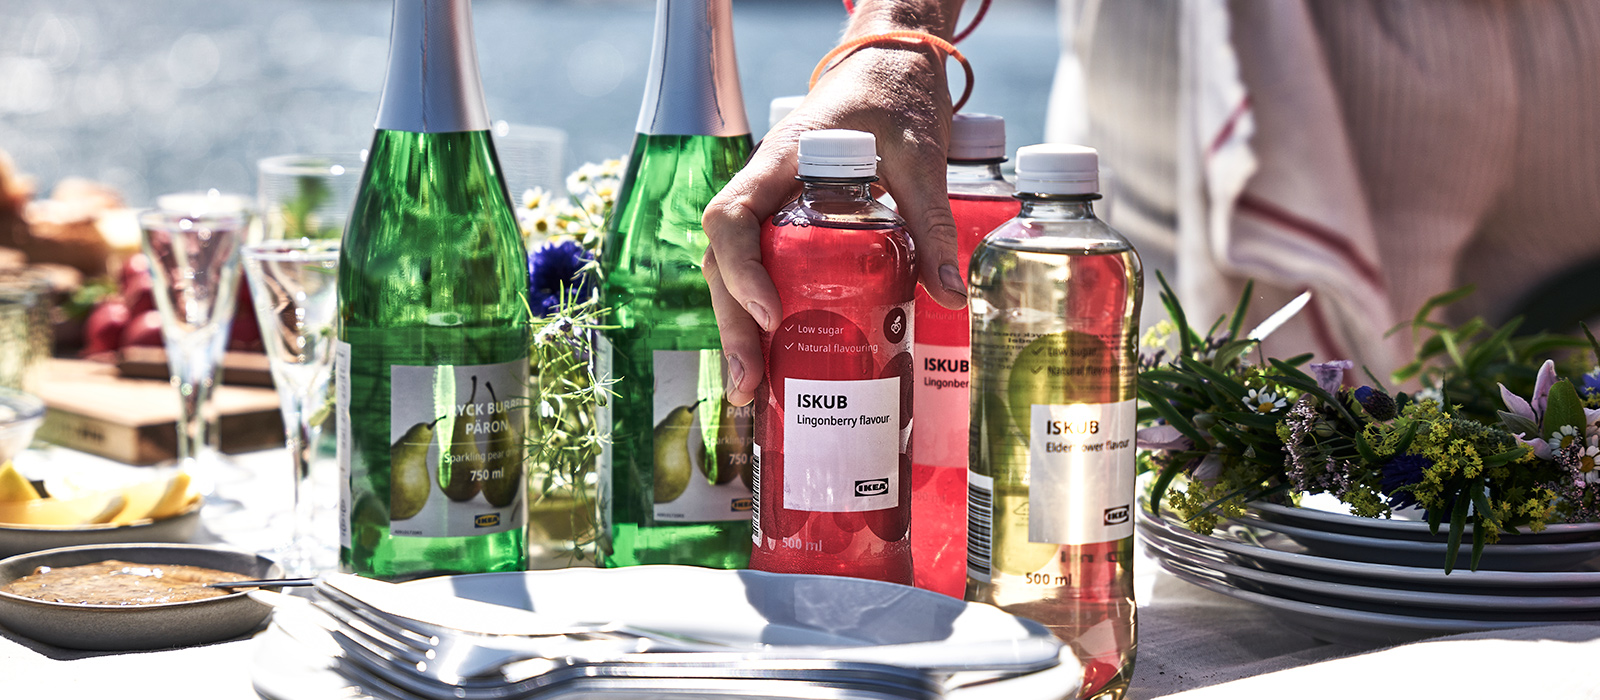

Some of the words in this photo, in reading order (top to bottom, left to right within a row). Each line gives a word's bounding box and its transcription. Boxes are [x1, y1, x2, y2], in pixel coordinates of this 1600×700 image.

[797, 324, 816, 334] Low
[817, 326, 844, 337] sugar
[797, 342, 832, 353] Natural
[833, 343, 879, 354] flavouring
[924, 357, 969, 373] ISKUB
[924, 376, 969, 390] Lingonber
[797, 393, 848, 409] ISKUB
[465, 420, 508, 435] PÄRON
[797, 414, 858, 429] Lingonberry
[859, 414, 890, 425] flavour
[1046, 420, 1099, 435] ISKUB
[1046, 441, 1103, 453] Elderower
[1105, 439, 1130, 450] flavour
[444, 452, 486, 465] Sparkling
[729, 454, 748, 465] 750
[470, 470, 490, 481] 750
[492, 467, 504, 479] ml
[782, 537, 802, 550] 500
[806, 539, 823, 552] ml
[1026, 573, 1050, 584] 500
[1054, 574, 1072, 586] ml
